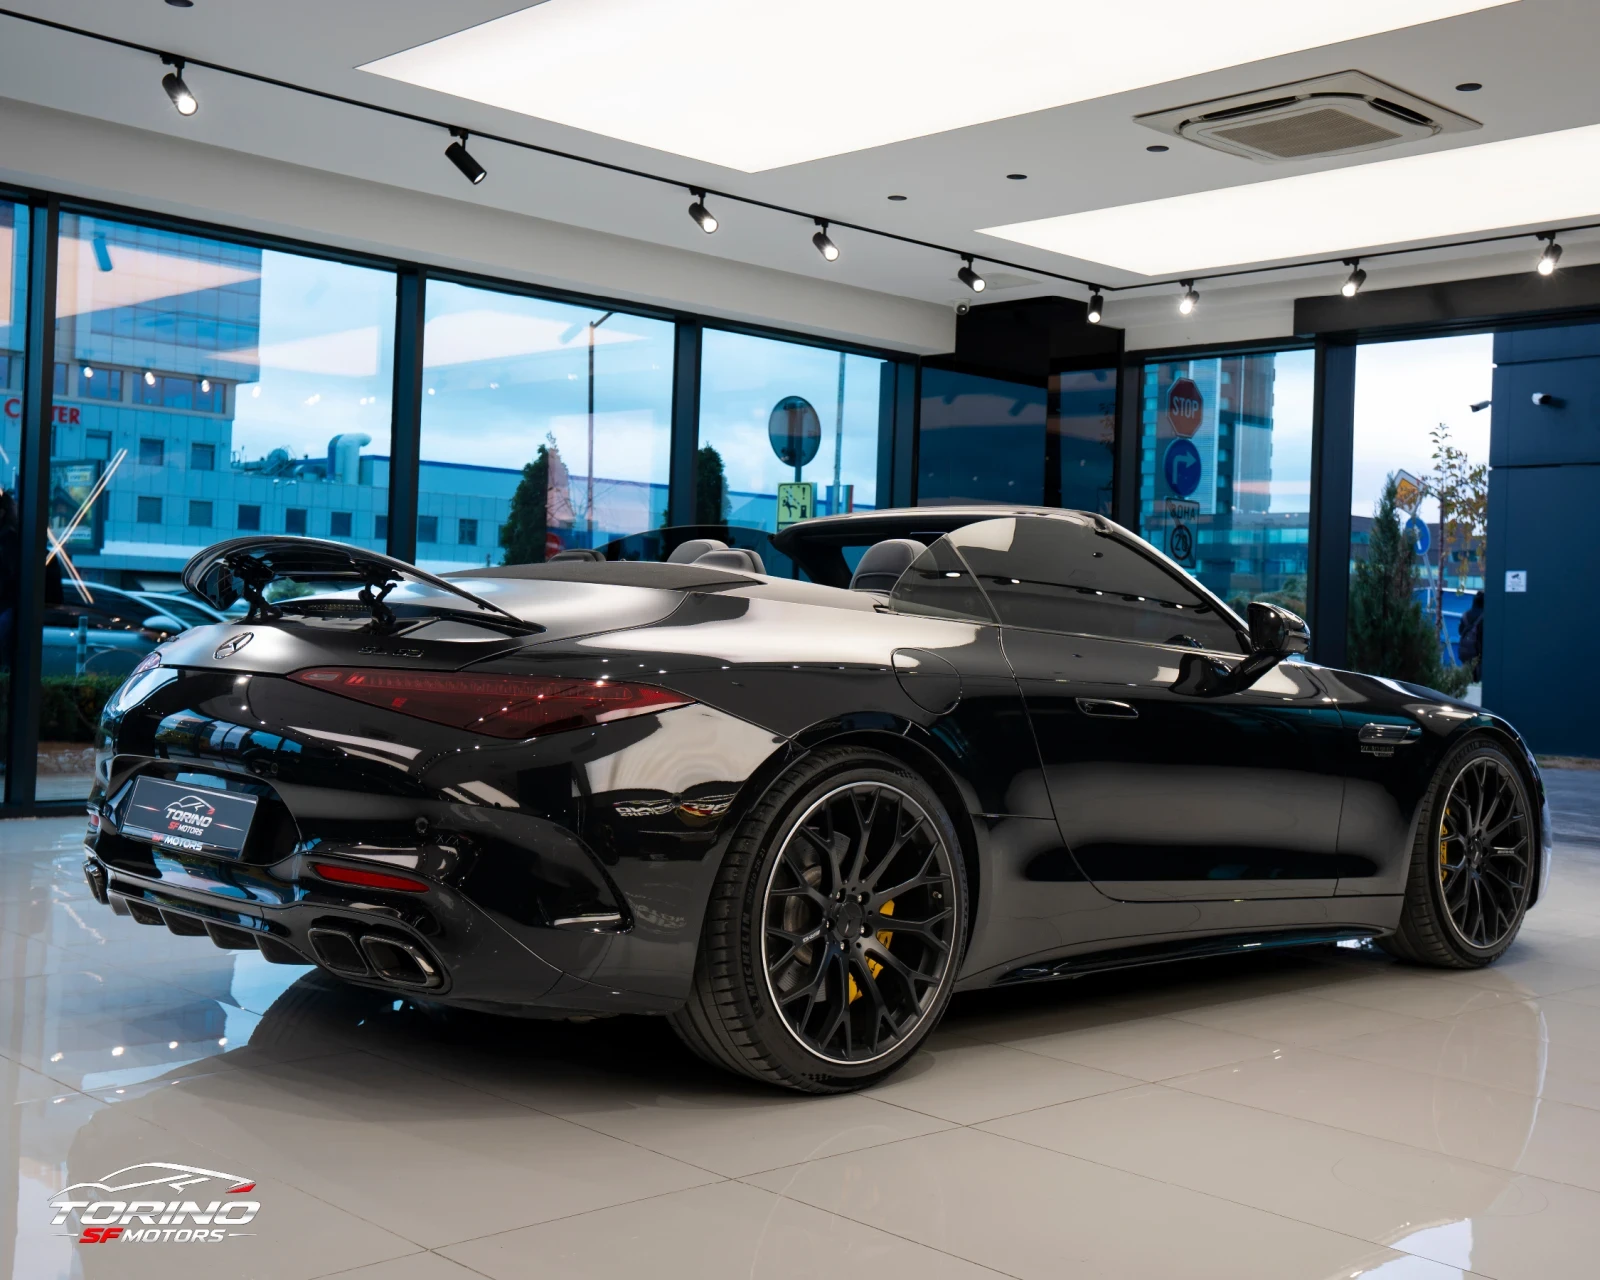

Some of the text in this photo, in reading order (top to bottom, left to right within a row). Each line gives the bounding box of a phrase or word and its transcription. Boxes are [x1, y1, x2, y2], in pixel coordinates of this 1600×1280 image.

[4, 398, 81, 425] CTER
[1172, 396, 1199, 419] STOP
[165, 808, 212, 827] TORINO
[168, 822, 203, 835] SF MOTORS
[164, 835, 203, 850] MOTORS
[741, 912, 758, 997] MICHELIN
